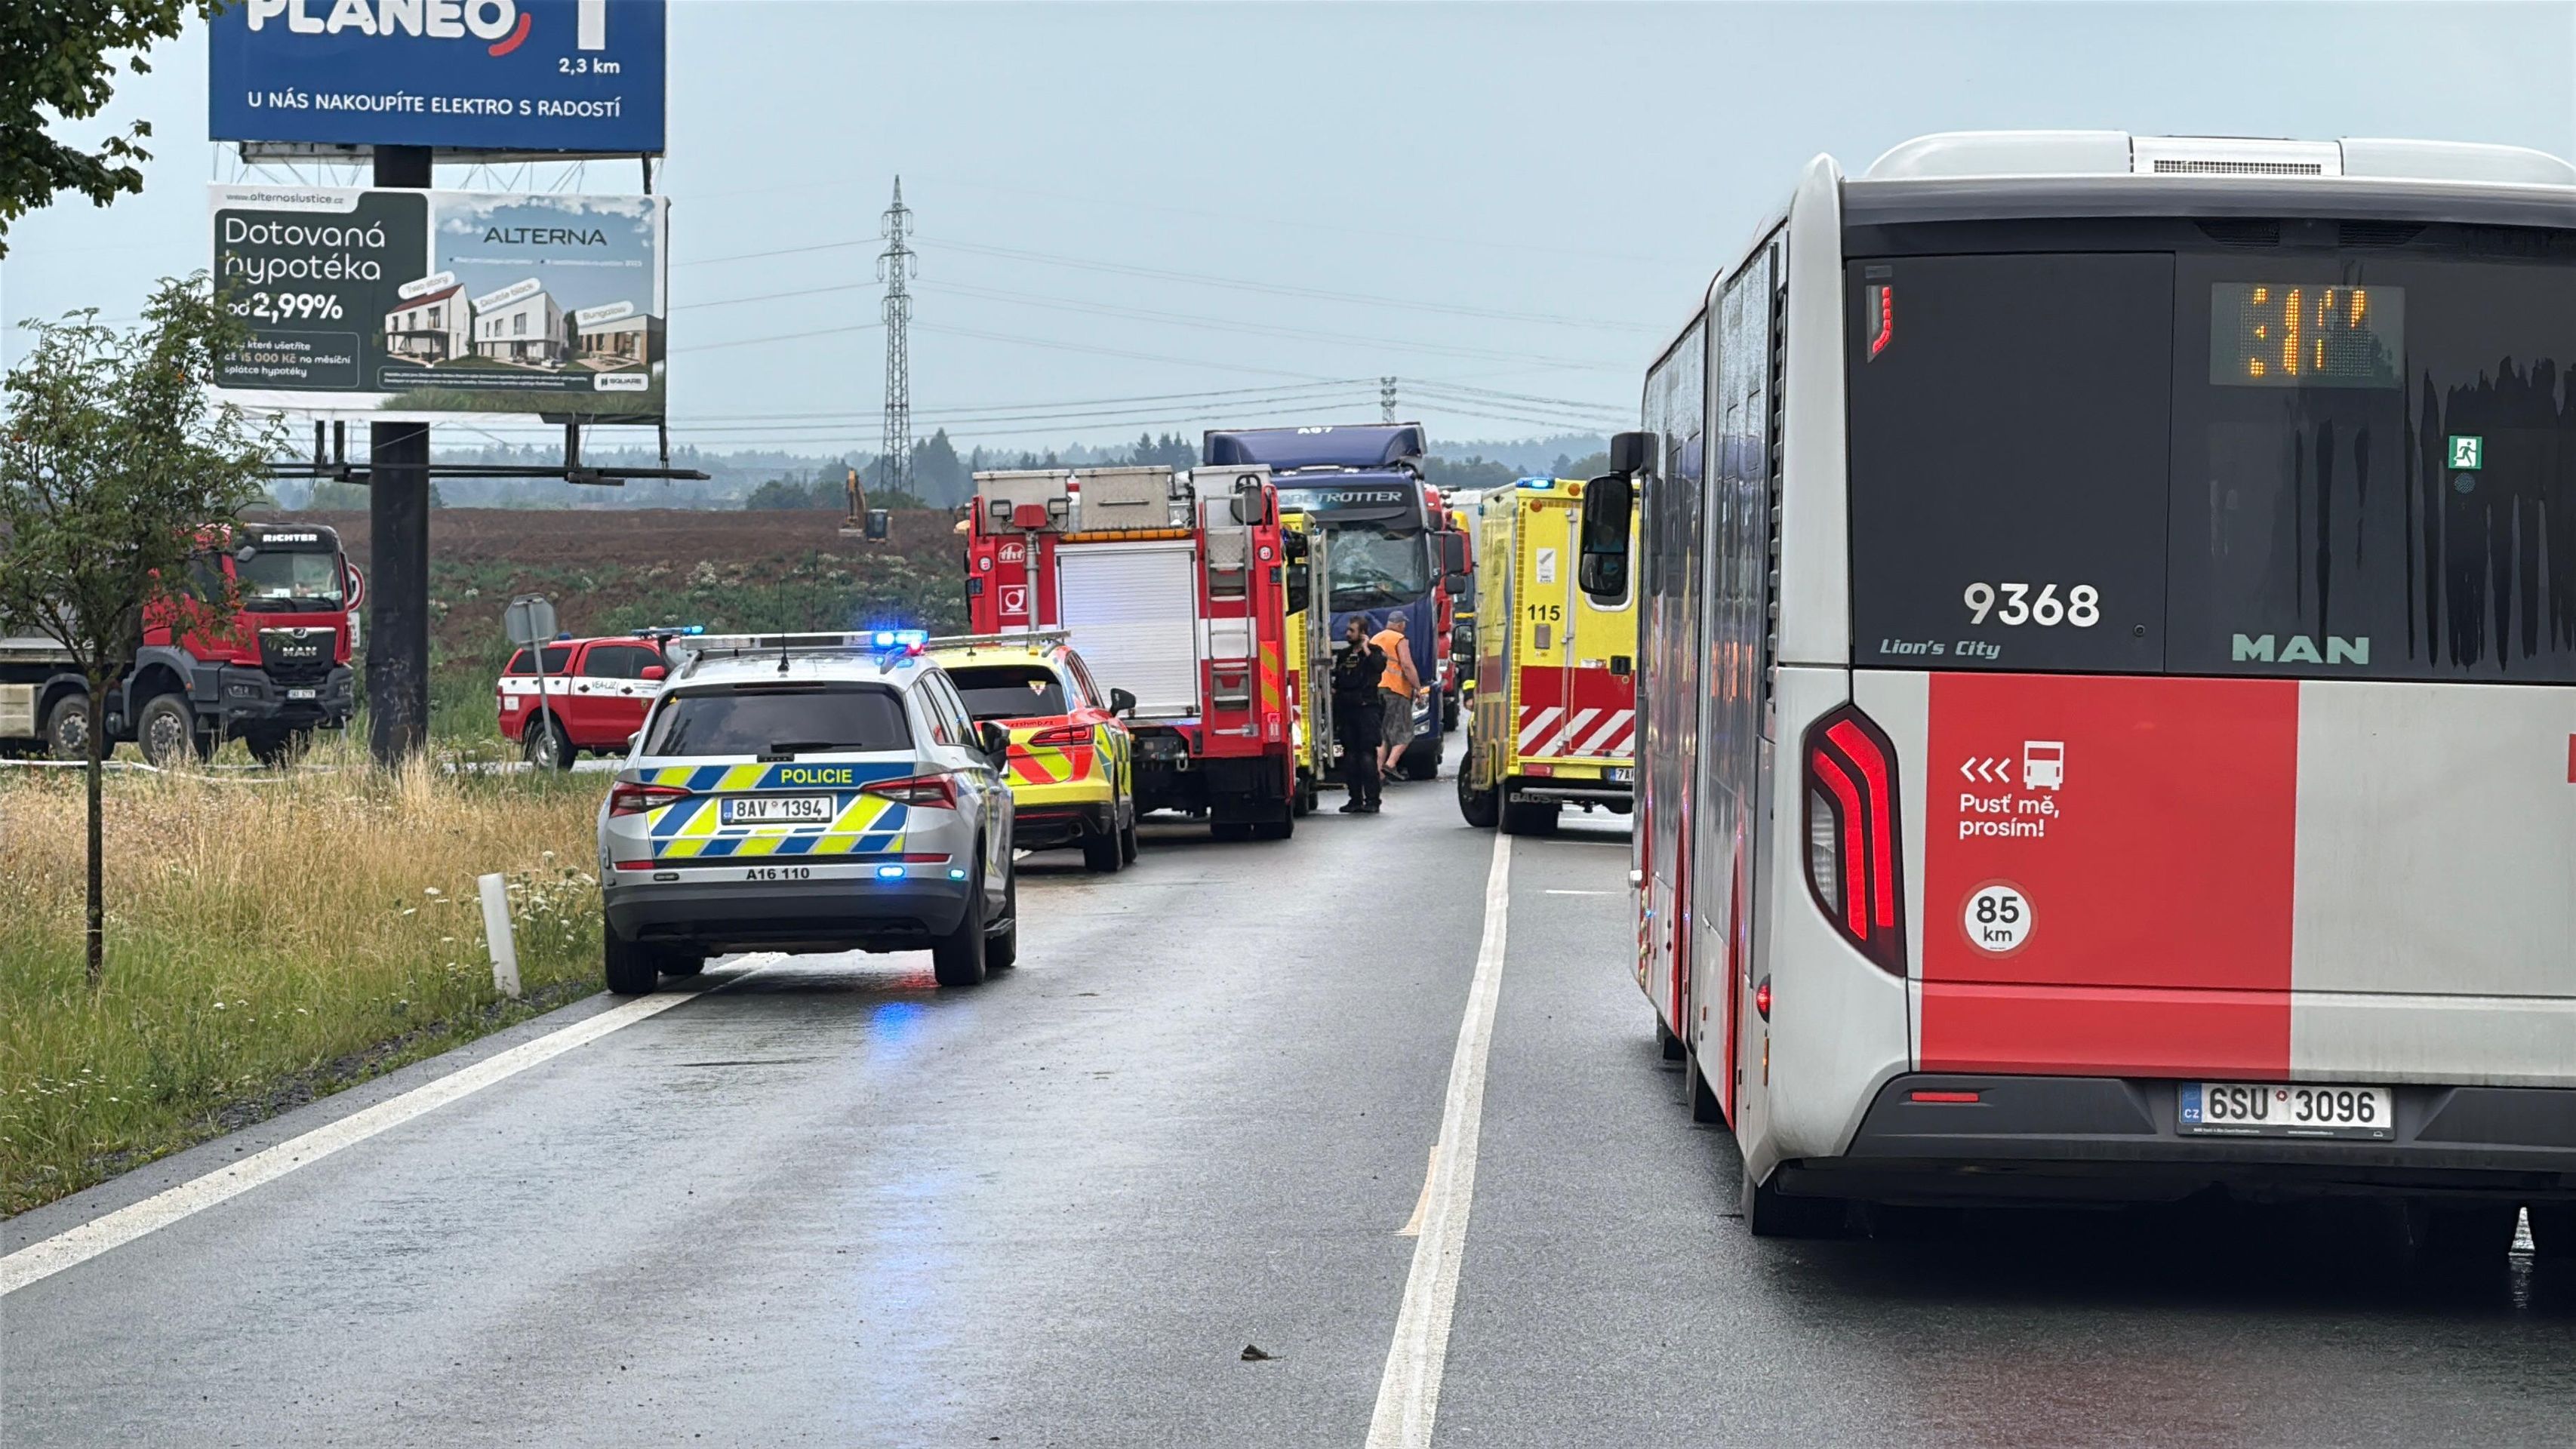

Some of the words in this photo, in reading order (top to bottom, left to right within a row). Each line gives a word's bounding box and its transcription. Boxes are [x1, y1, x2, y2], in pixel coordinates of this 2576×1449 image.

[248, 0, 516, 39] PLANEO
[559, 57, 587, 75] 2,3
[593, 57, 620, 74] km
[248, 91, 263, 108] U
[269, 87, 309, 109] NÁS
[315, 91, 425, 112] NAKOUPÍTE
[431, 97, 514, 115] ELEKTRO
[519, 100, 531, 115] S
[537, 97, 621, 117] RADOSTÍ
[226, 217, 386, 248] Dotovaná
[483, 227, 608, 245] ALTERNA
[225, 249, 381, 285] hypotéka
[252, 291, 343, 325] 2,99%
[247, 340, 272, 351] které
[254, 352, 279, 364] 000
[282, 353, 297, 364] Kč
[314, 354, 352, 365] měsíční
[261, 367, 308, 378] hypotéky
[1528, 604, 1561, 621] 115
[1963, 582, 2101, 627] 9368
[283, 647, 317, 657] MAN
[1879, 639, 1946, 655] Lion's
[1955, 641, 2001, 660] City
[2232, 633, 2370, 665] MAN
[780, 769, 853, 783] POLICIE
[737, 801, 767, 817] 8AV
[782, 800, 822, 817] 1394
[1960, 793, 2013, 814] Pusť
[2018, 795, 2060, 819] mě,
[1959, 817, 2045, 840] prosím!
[746, 869, 776, 881] A16
[781, 868, 810, 880] 110
[1976, 895, 2020, 924] 85
[1984, 925, 2013, 942] km
[2184, 1108, 2200, 1119] CZ
[2208, 1087, 2269, 1121] 6SU
[2295, 1090, 2376, 1124] 3096
